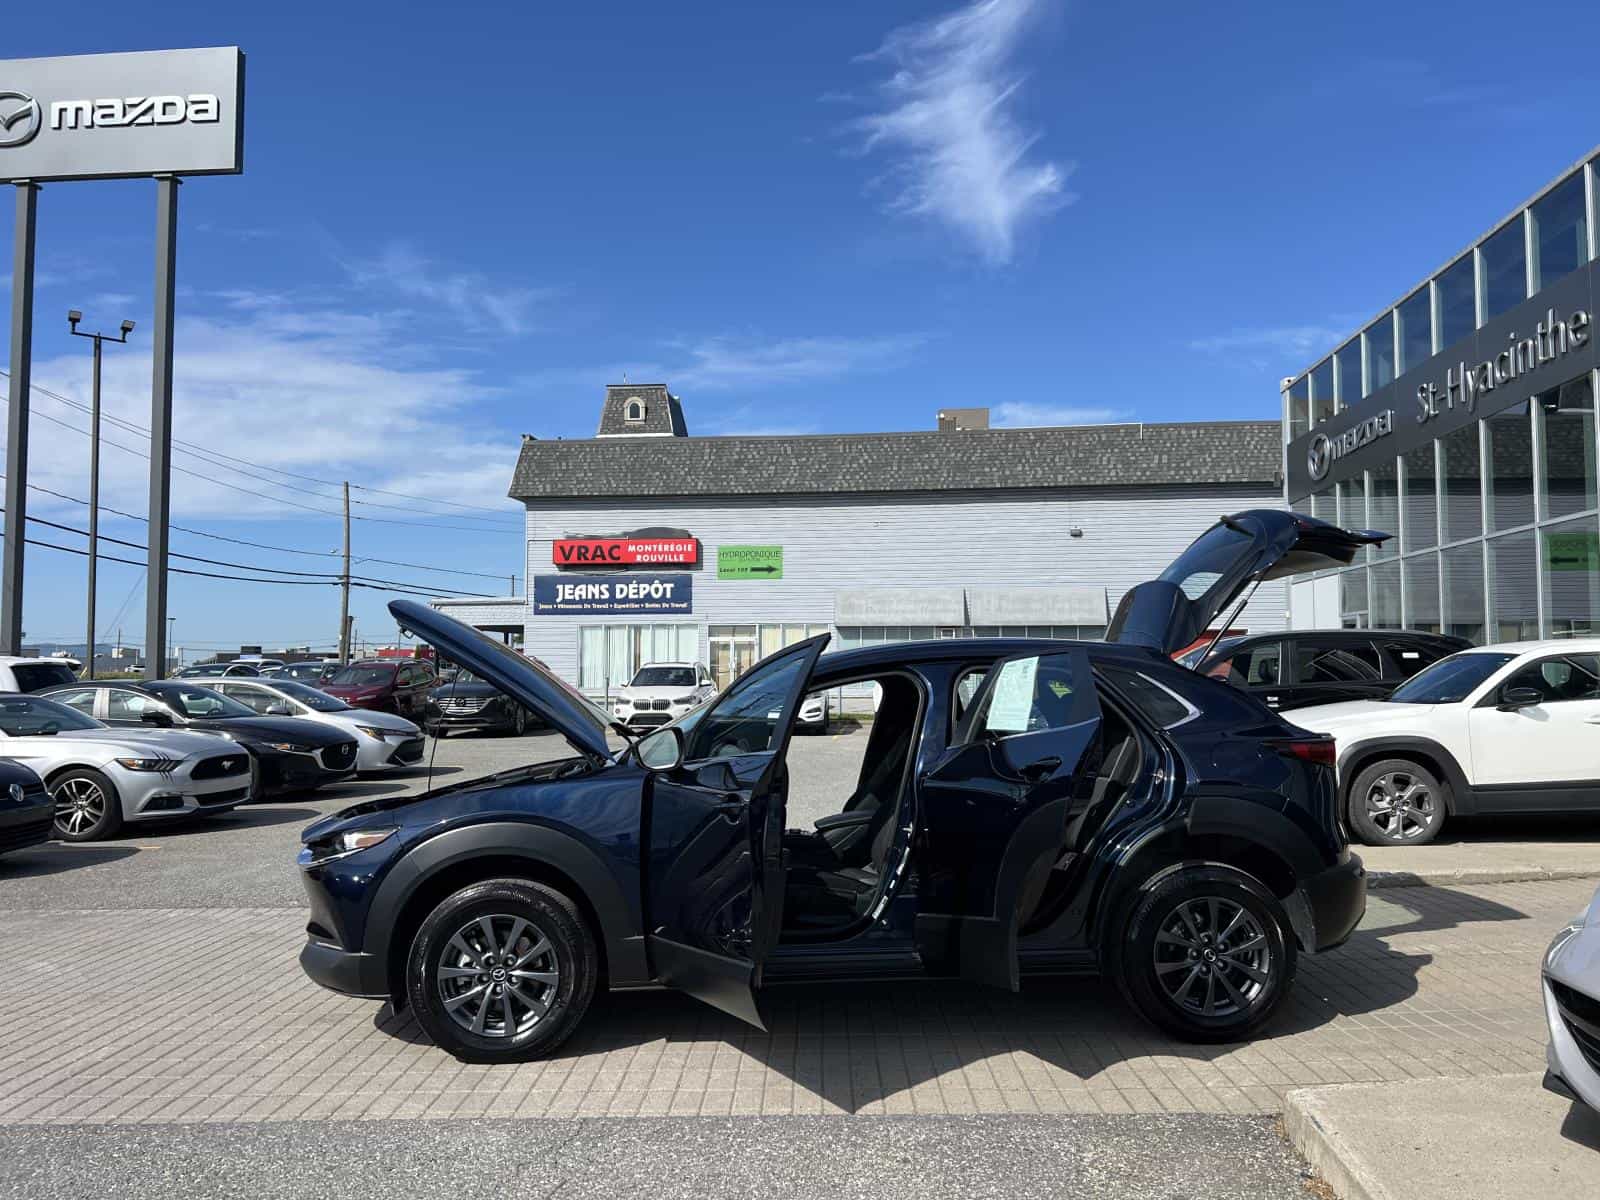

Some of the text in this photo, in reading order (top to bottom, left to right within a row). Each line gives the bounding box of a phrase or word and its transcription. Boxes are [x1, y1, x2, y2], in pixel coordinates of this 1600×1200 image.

[51, 94, 219, 129] mazda
[1416, 307, 1590, 423] St-Hyacinthe
[1330, 409, 1393, 460] mazda
[559, 544, 621, 561] VRAC
[628, 542, 693, 553] MONTÉRÉGIE
[636, 553, 685, 563] ROUVILLE
[556, 580, 674, 603] JEANS DÉPÔT
